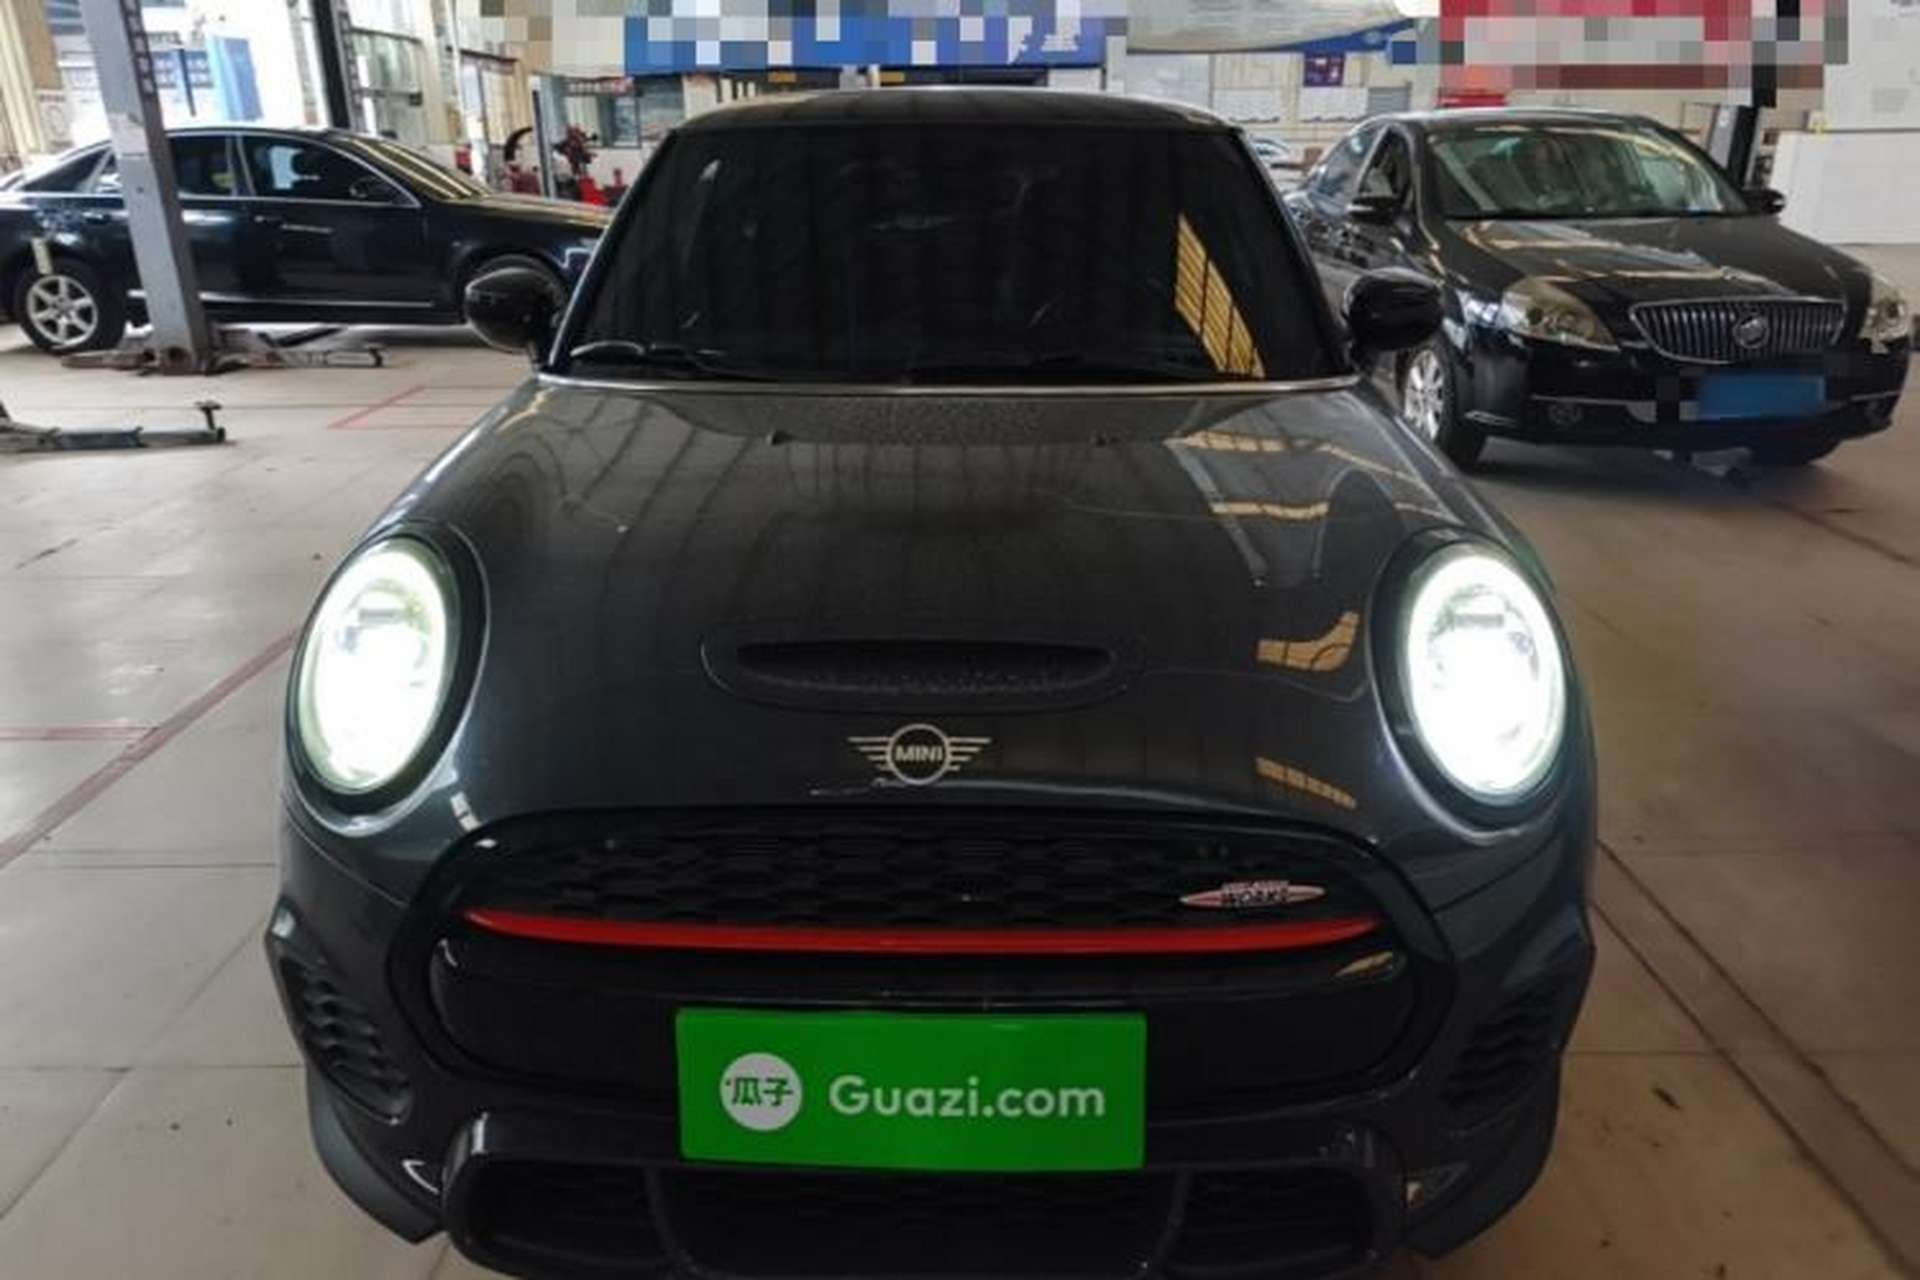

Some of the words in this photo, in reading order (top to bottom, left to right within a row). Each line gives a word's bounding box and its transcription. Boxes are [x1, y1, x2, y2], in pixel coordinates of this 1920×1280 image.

[895, 746, 943, 762] MINI
[729, 1077, 794, 1107] 瓜子
[829, 1075, 1106, 1118] Guazi.com
